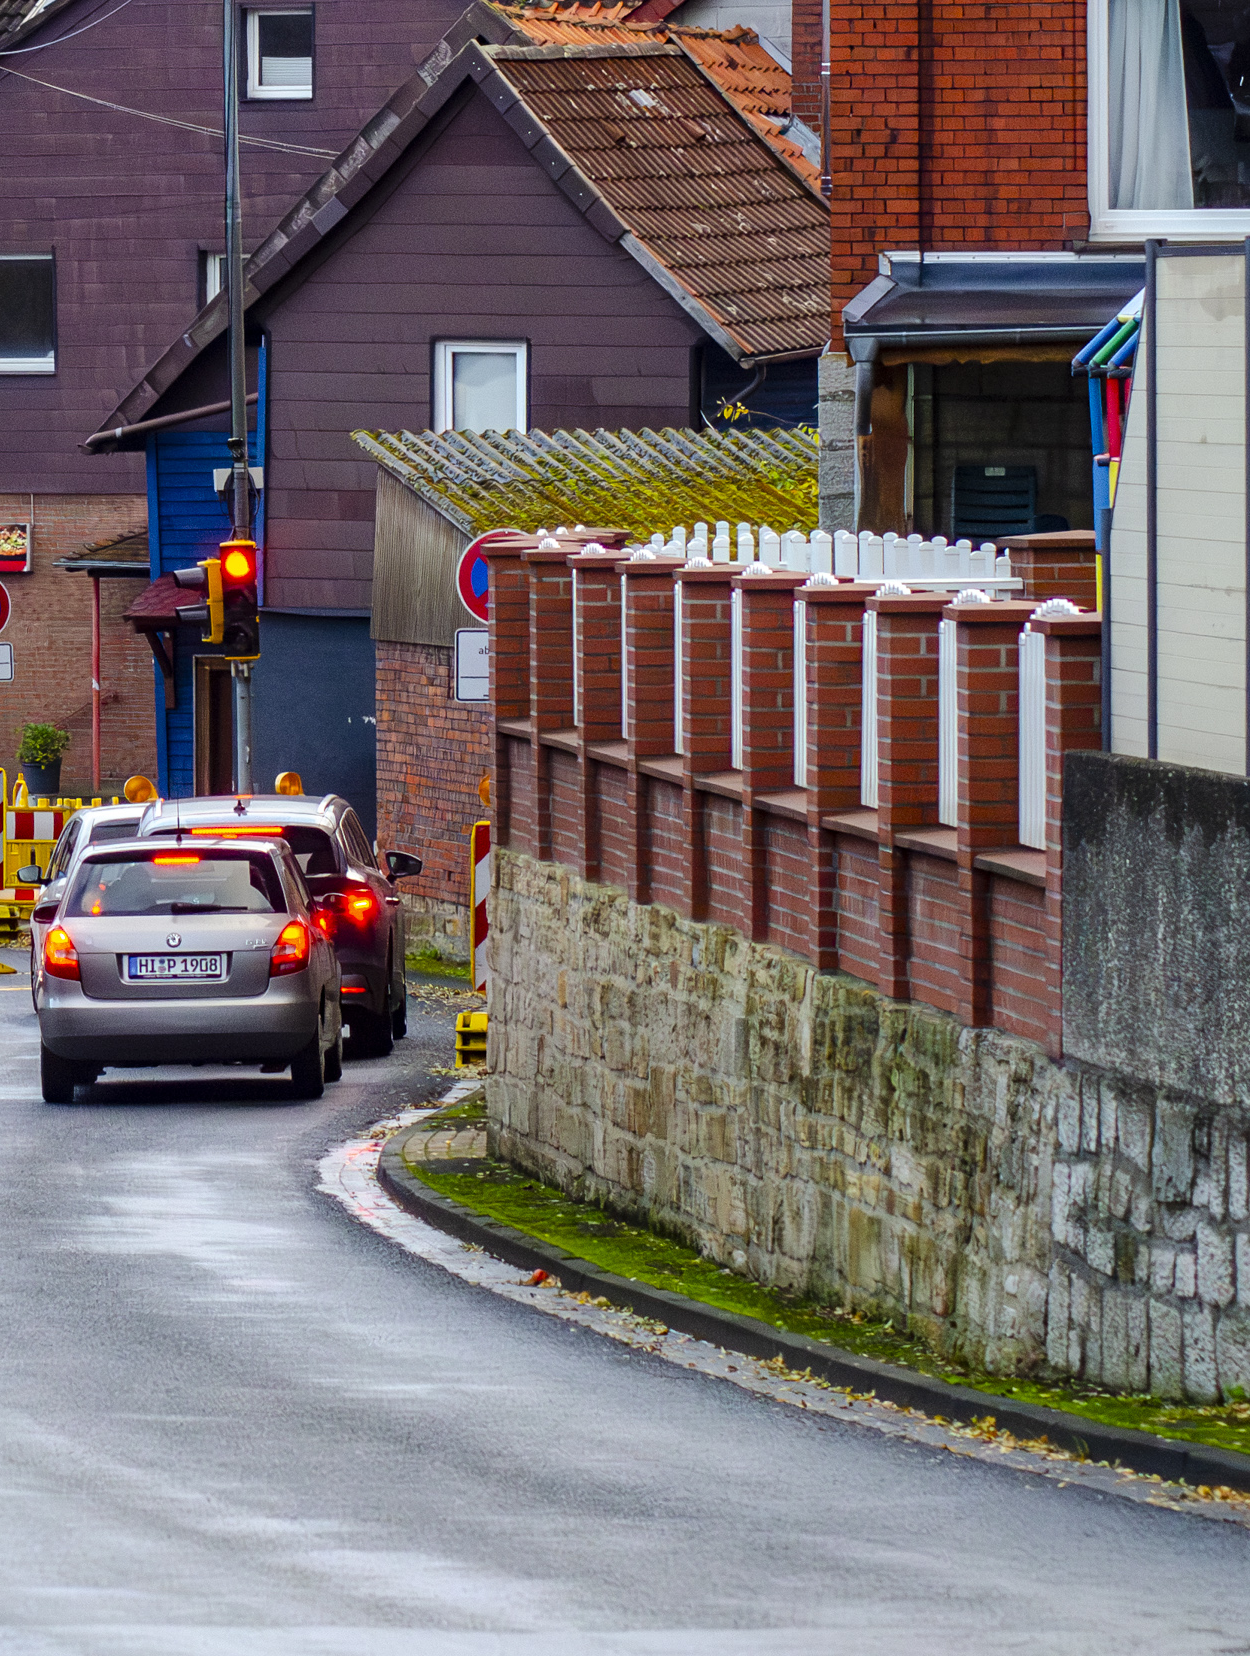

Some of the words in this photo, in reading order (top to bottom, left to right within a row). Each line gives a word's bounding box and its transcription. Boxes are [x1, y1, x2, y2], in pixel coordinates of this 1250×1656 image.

[138, 959, 157, 974] HI
[167, 958, 177, 972] P
[180, 957, 218, 973] 1908
